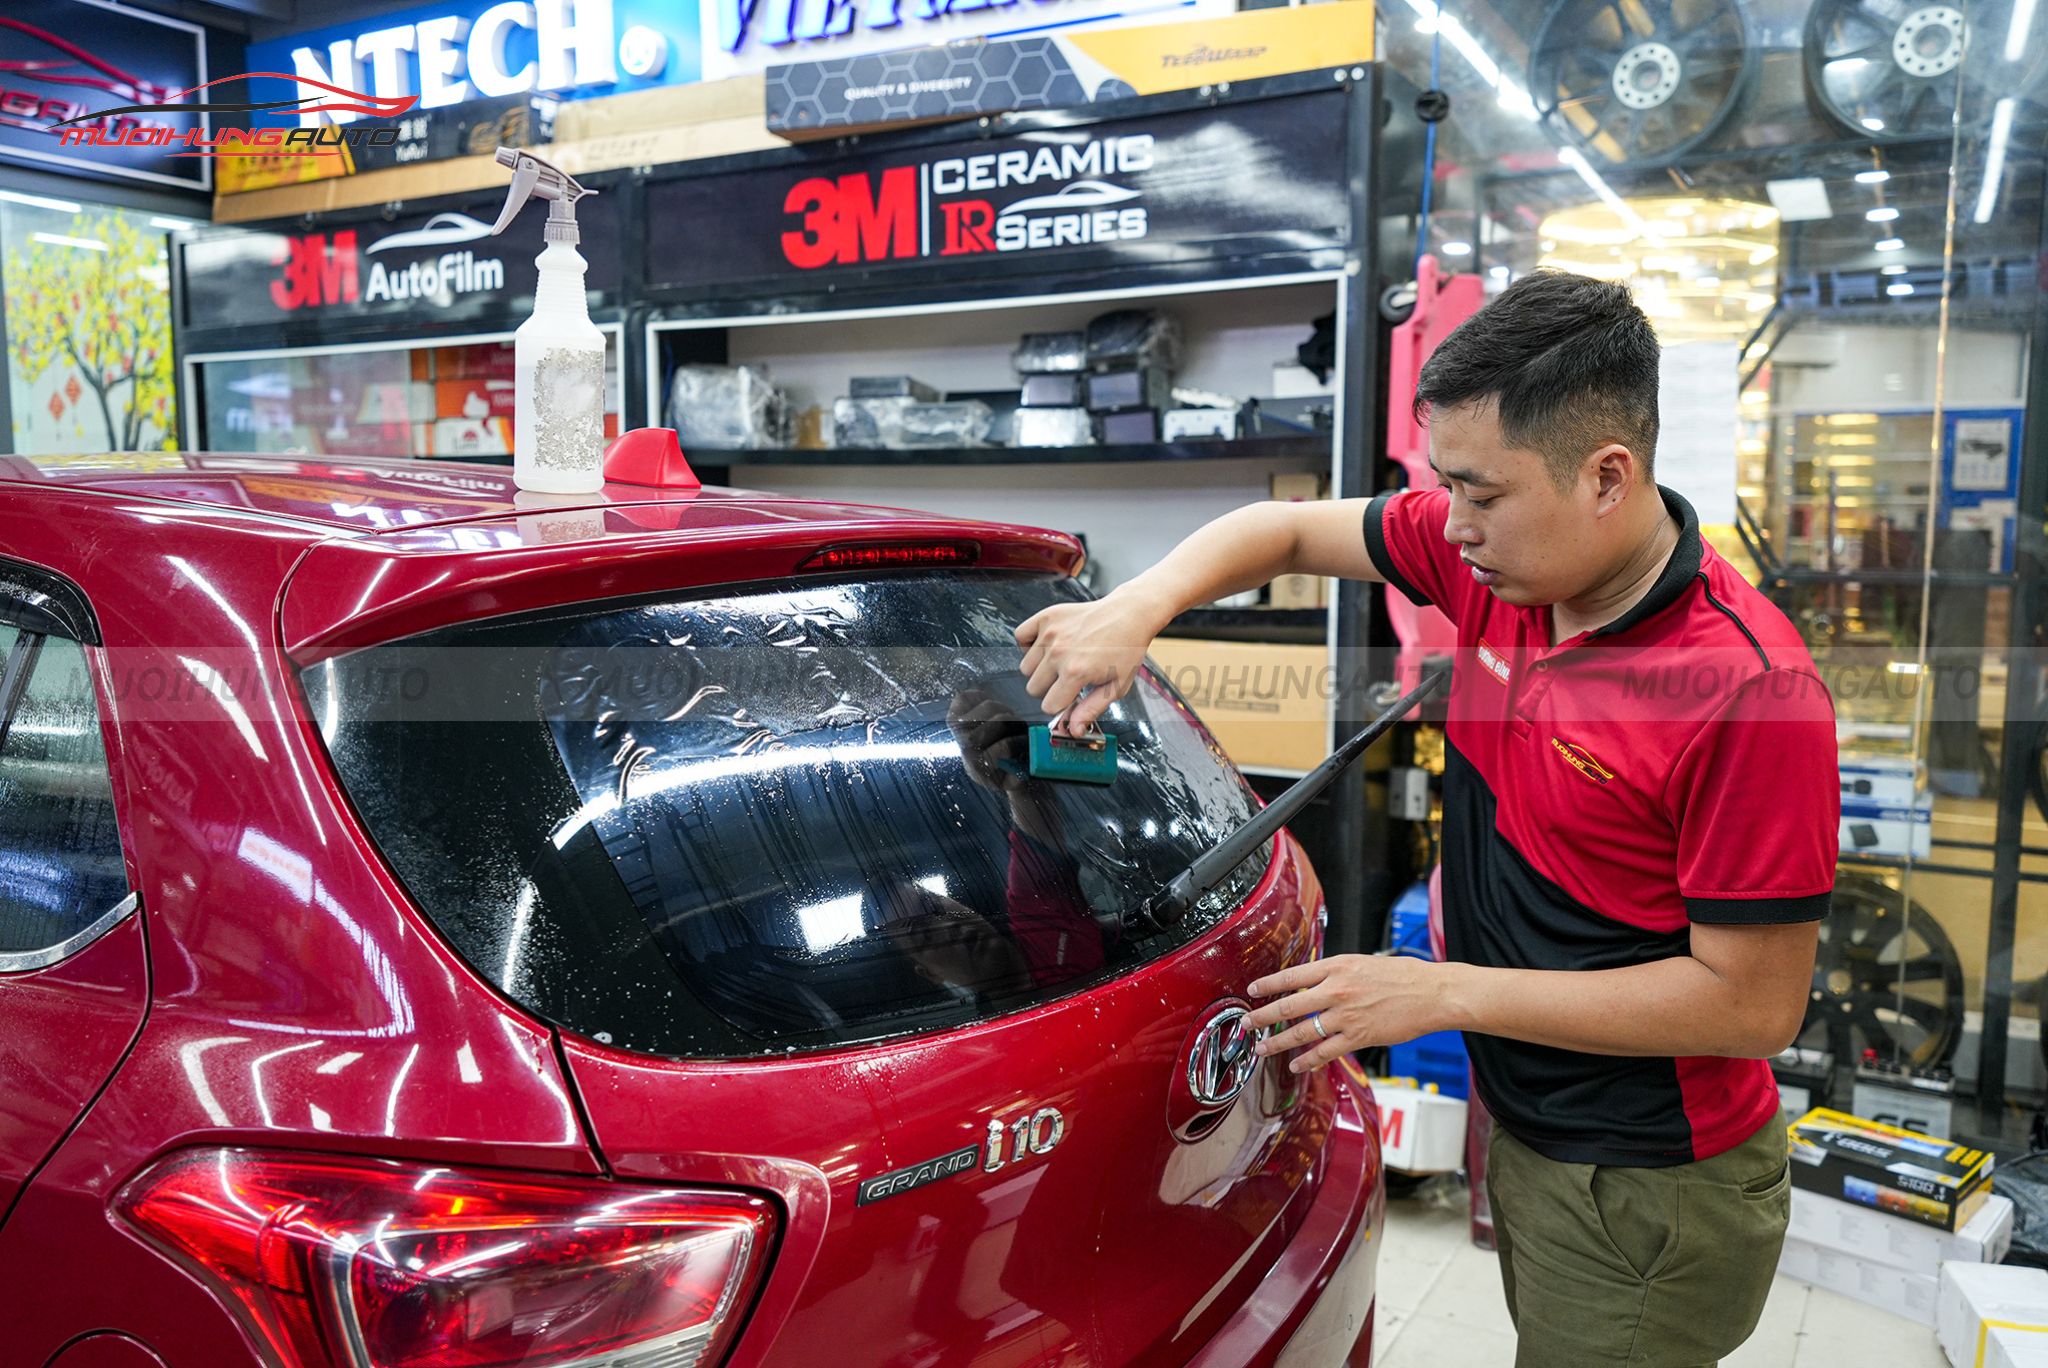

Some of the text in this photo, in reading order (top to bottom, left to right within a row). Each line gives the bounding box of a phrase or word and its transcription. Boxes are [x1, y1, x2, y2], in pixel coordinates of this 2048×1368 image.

[932, 134, 1155, 195] CERAMIC
[781, 165, 918, 269] 3M
[995, 207, 1148, 252] SERIES
[269, 230, 505, 311] 3M AutoFilm
[866, 1107, 1065, 1201] GRAND i10
